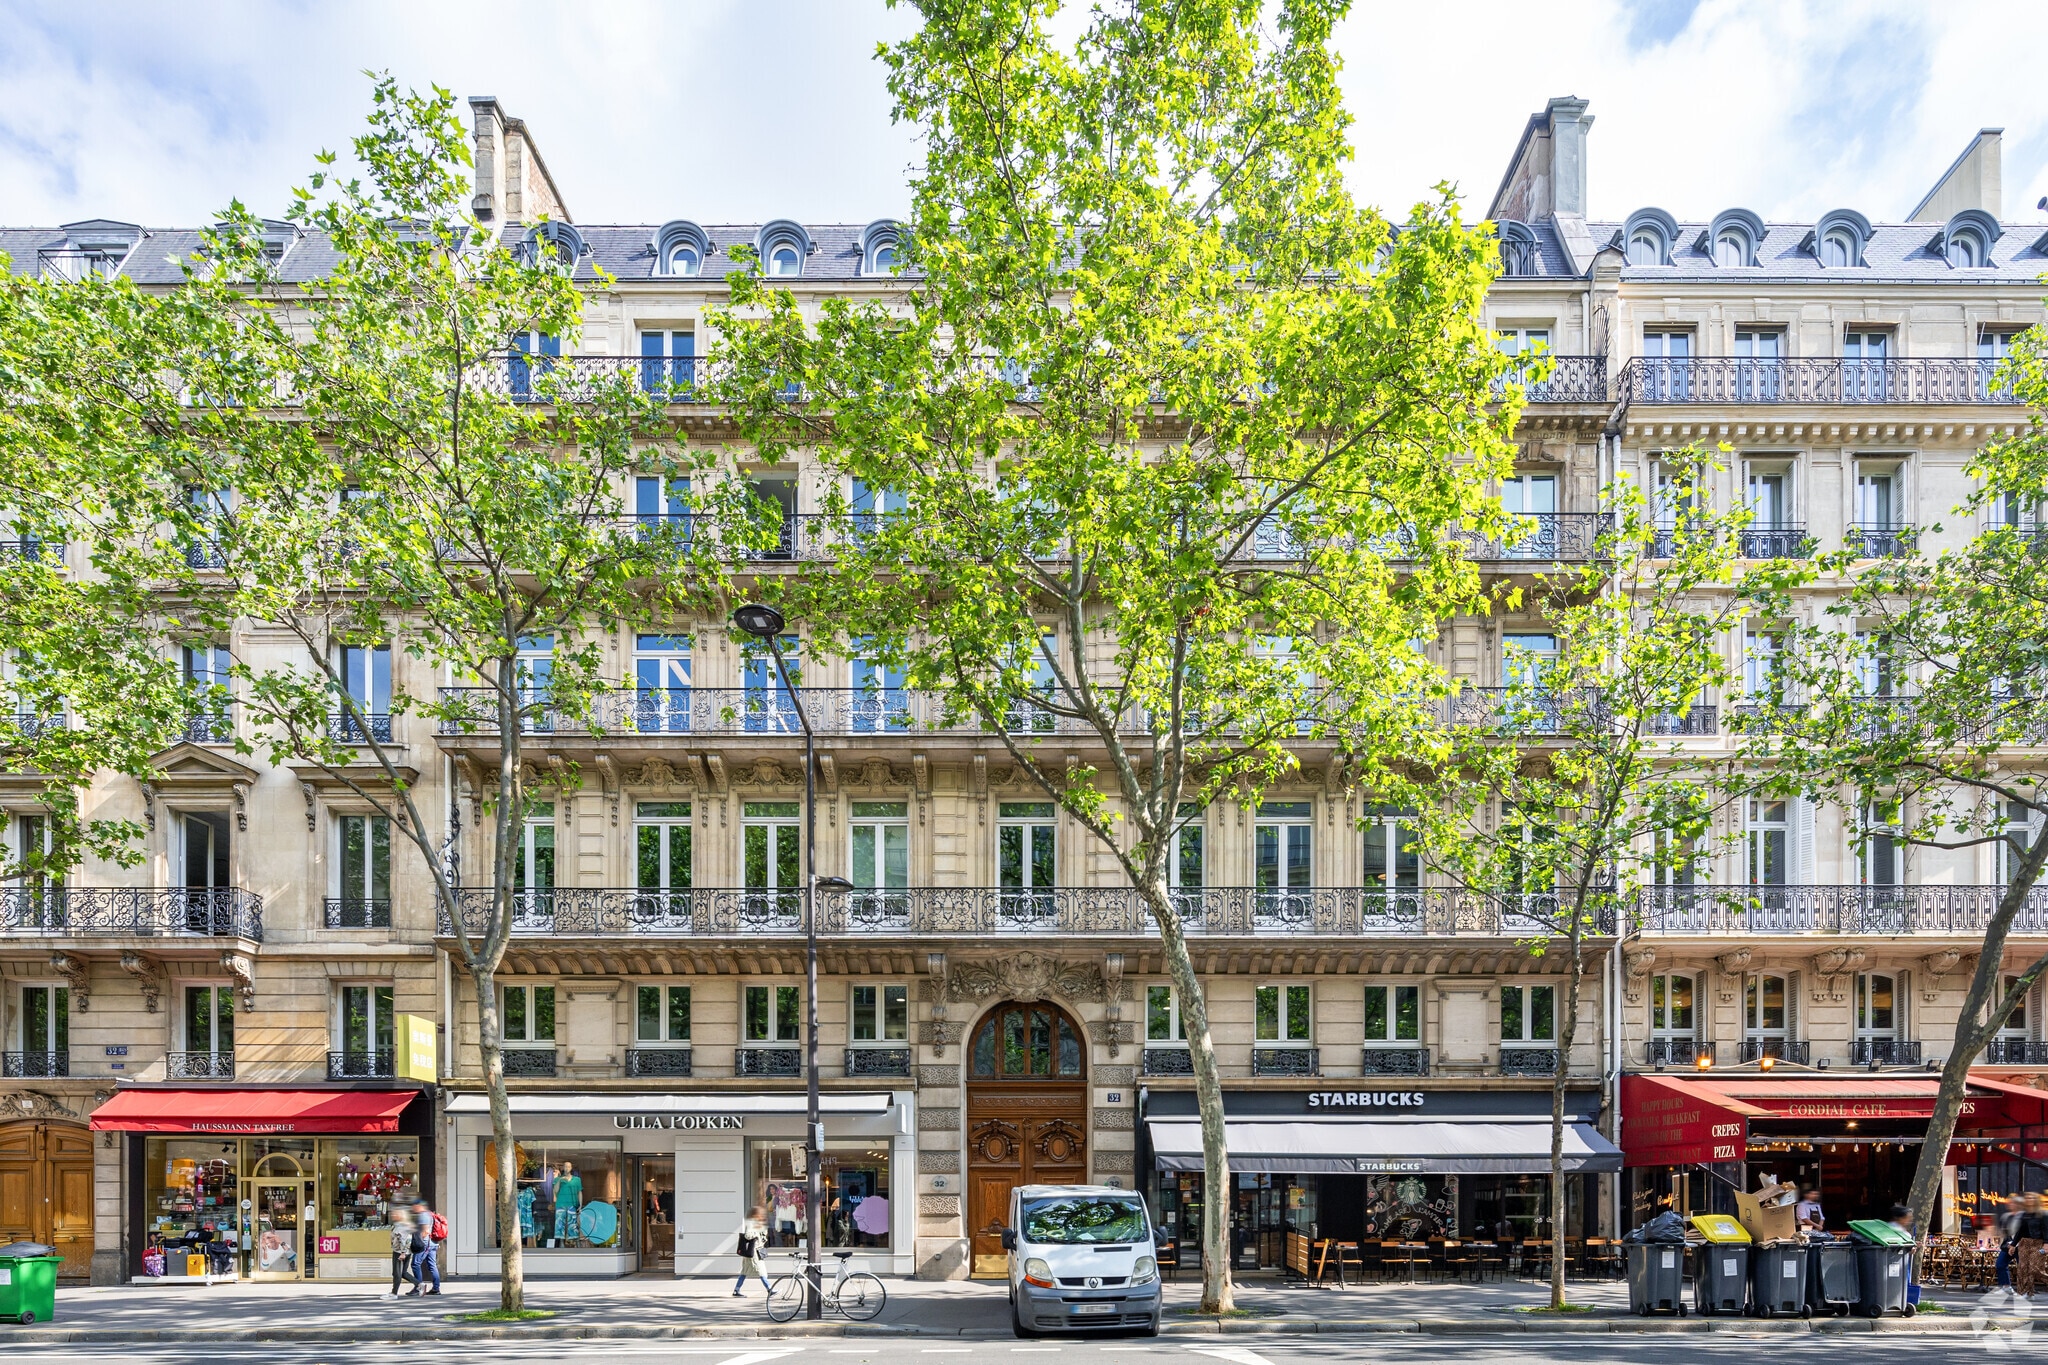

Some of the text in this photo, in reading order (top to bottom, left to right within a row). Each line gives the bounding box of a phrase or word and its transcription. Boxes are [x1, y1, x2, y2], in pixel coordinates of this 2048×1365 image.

[107, 1047, 117, 1055] 32
[1108, 1093, 1119, 1102] 32
[1308, 1092, 1424, 1106] STARBUCKS
[1641, 1097, 1684, 1113] HAPPY HOURS
[1788, 1104, 1887, 1116] CORDIAL CAFE
[613, 1115, 743, 1129] ULLA POPKEN
[1662, 1110, 1701, 1127] BREAKFAST
[192, 1123, 295, 1132] HAUSSMANN TAXFREE
[1711, 1123, 1740, 1138] CREPES
[1713, 1145, 1736, 1159] PIZZA
[1359, 1162, 1421, 1171] STARBUCKS
[1957, 1170, 1967, 1178] 30
[1109, 1180, 1120, 1188] 32
